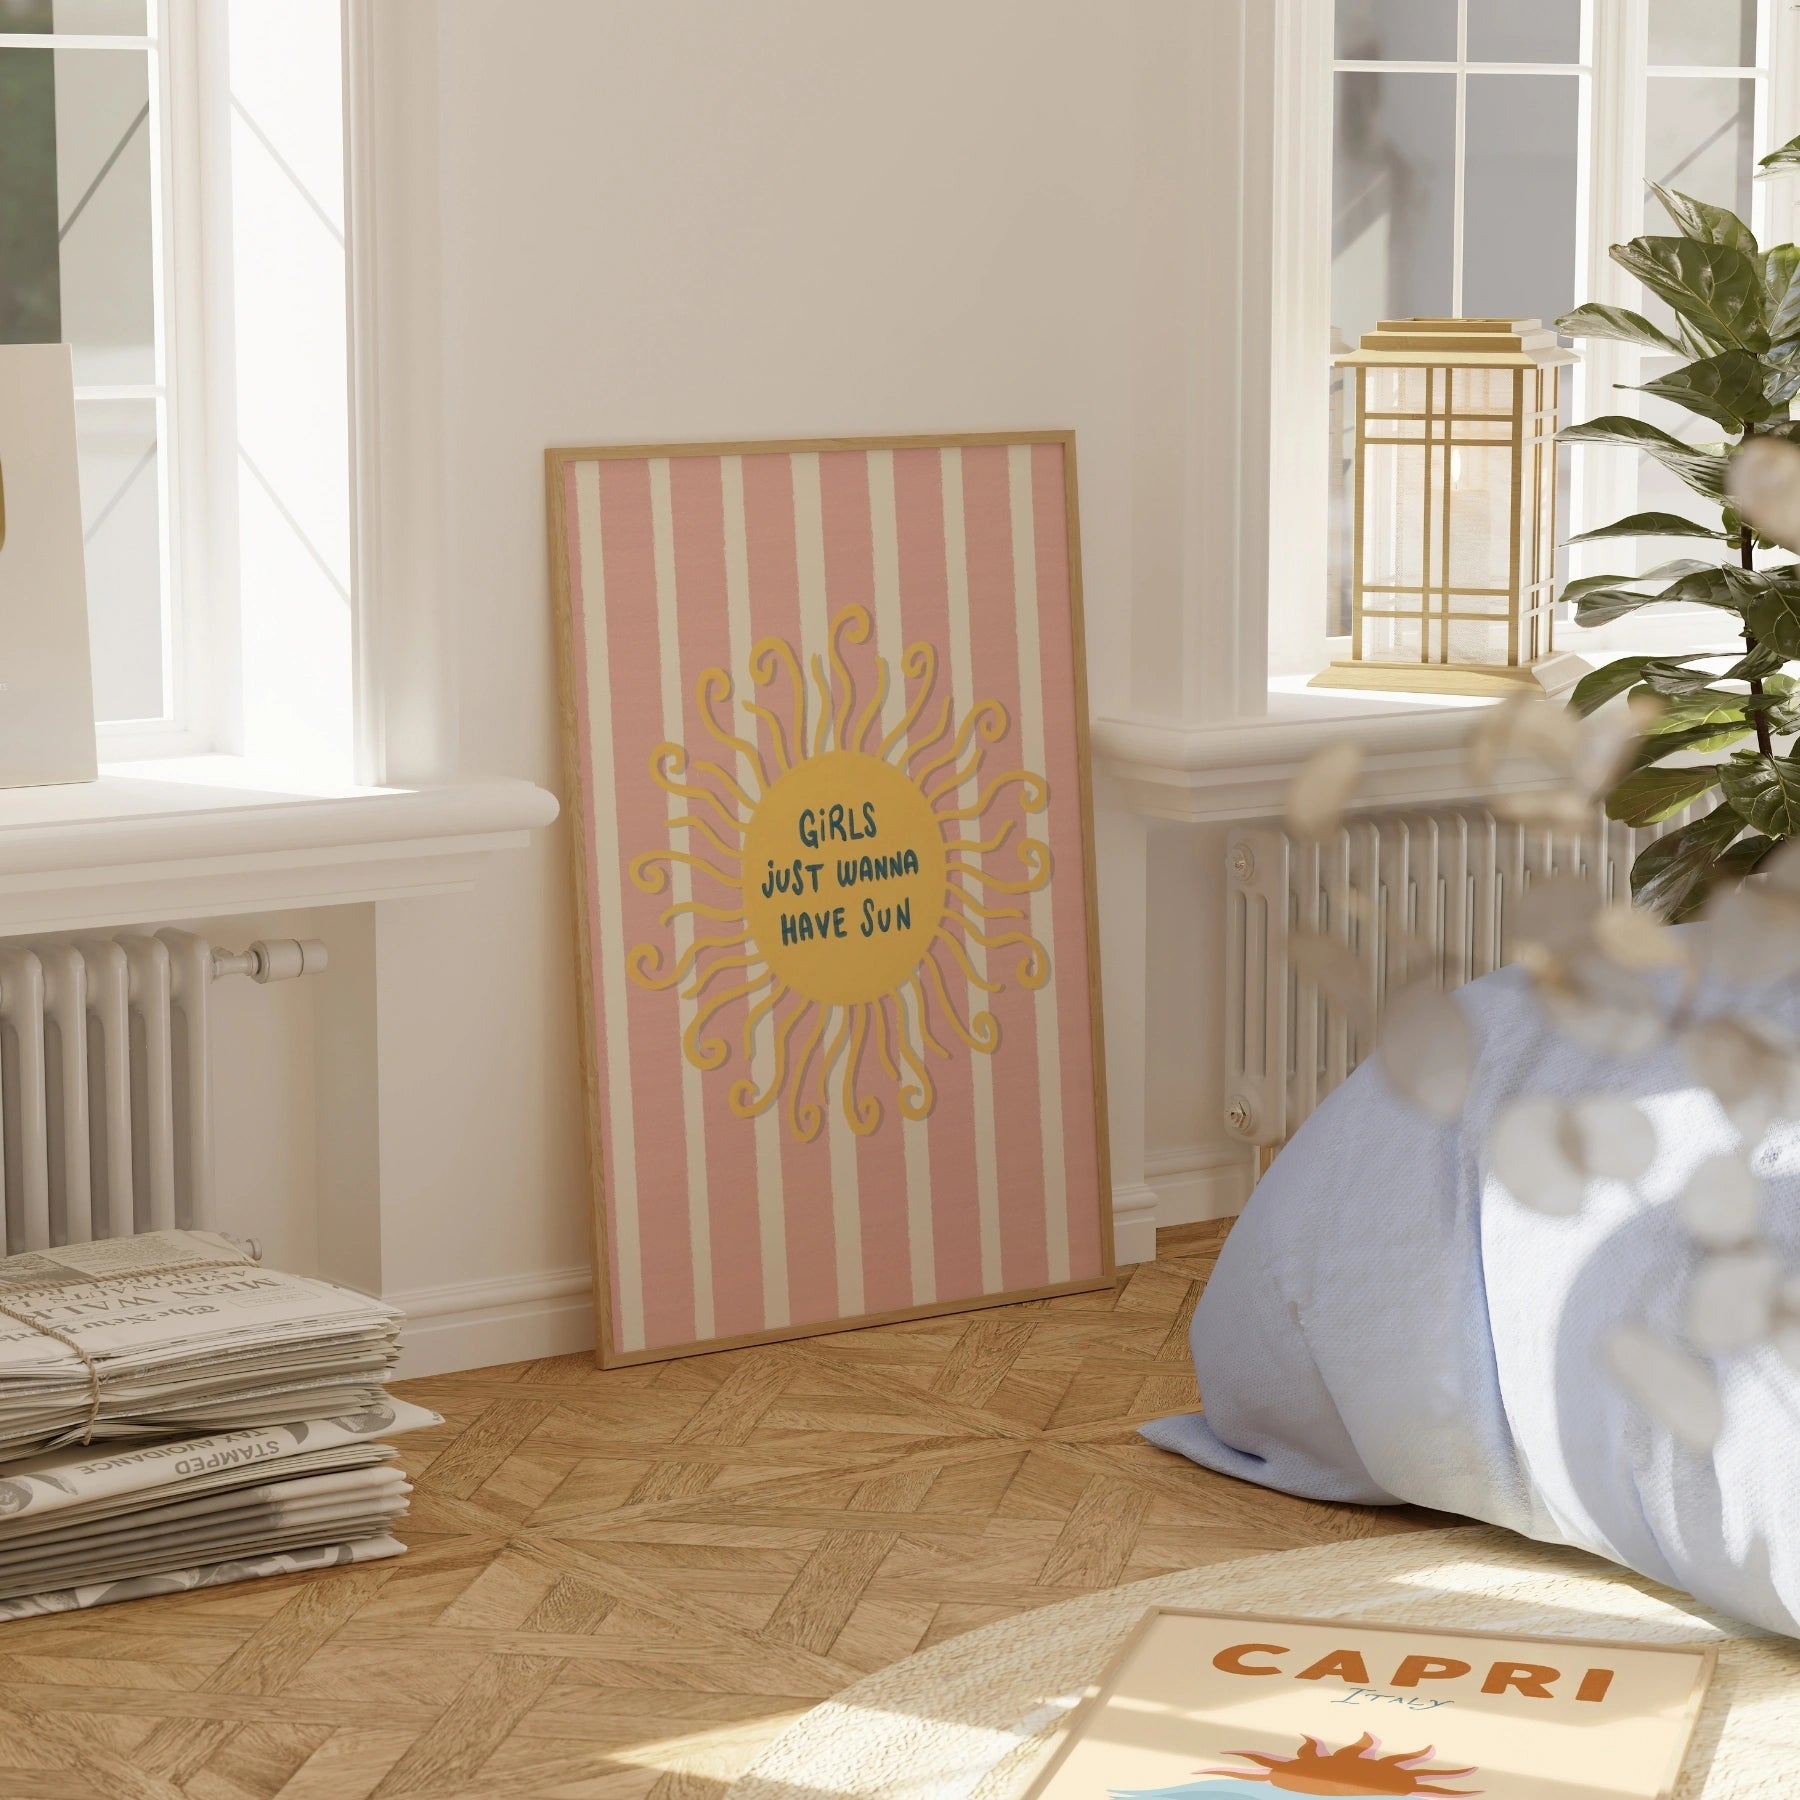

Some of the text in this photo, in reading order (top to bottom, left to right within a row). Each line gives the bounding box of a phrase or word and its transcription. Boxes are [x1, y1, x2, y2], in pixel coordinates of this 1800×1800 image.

[836, 849, 919, 888] WANNA
[780, 897, 911, 946] HAVE SUN
[171, 1277, 281, 1299] MEN
[158, 1304, 220, 1316] The
[75, 1430, 269, 1475] TAX AVOIDANCE
[174, 1440, 280, 1475] STAMPED
[1212, 1643, 1615, 1703] CAPRI
